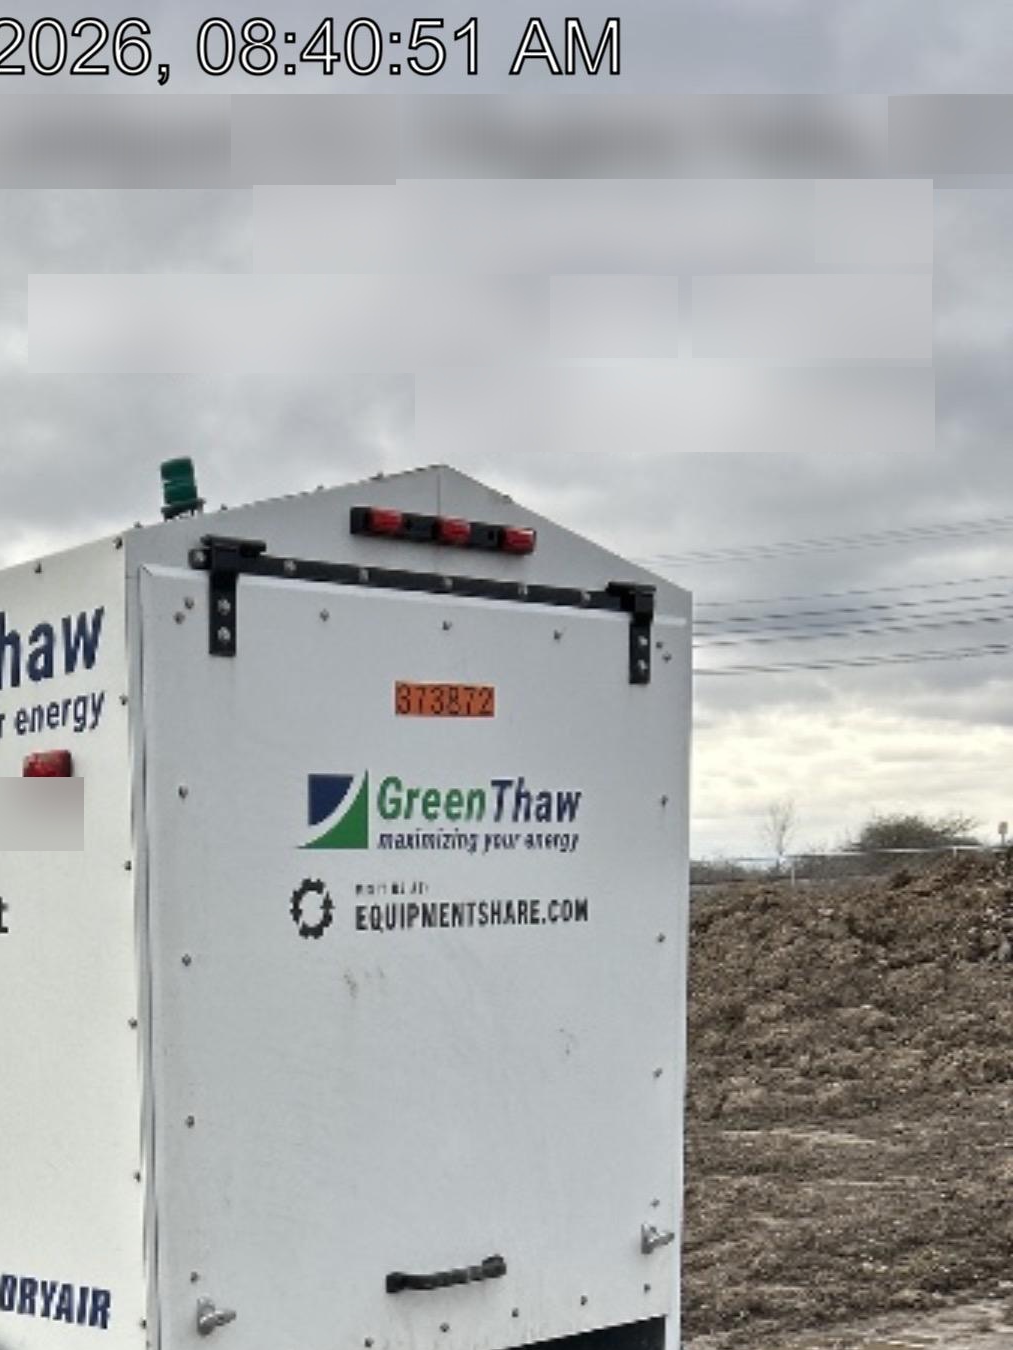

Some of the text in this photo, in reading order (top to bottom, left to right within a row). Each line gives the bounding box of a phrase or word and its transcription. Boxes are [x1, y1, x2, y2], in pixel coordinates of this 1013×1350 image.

[14, 691, 106, 737] energy
[396, 684, 494, 716] 373872
[376, 828, 580, 856] maximizing your energy
[355, 898, 589, 933] EQUIPMENTSHARE.COM
